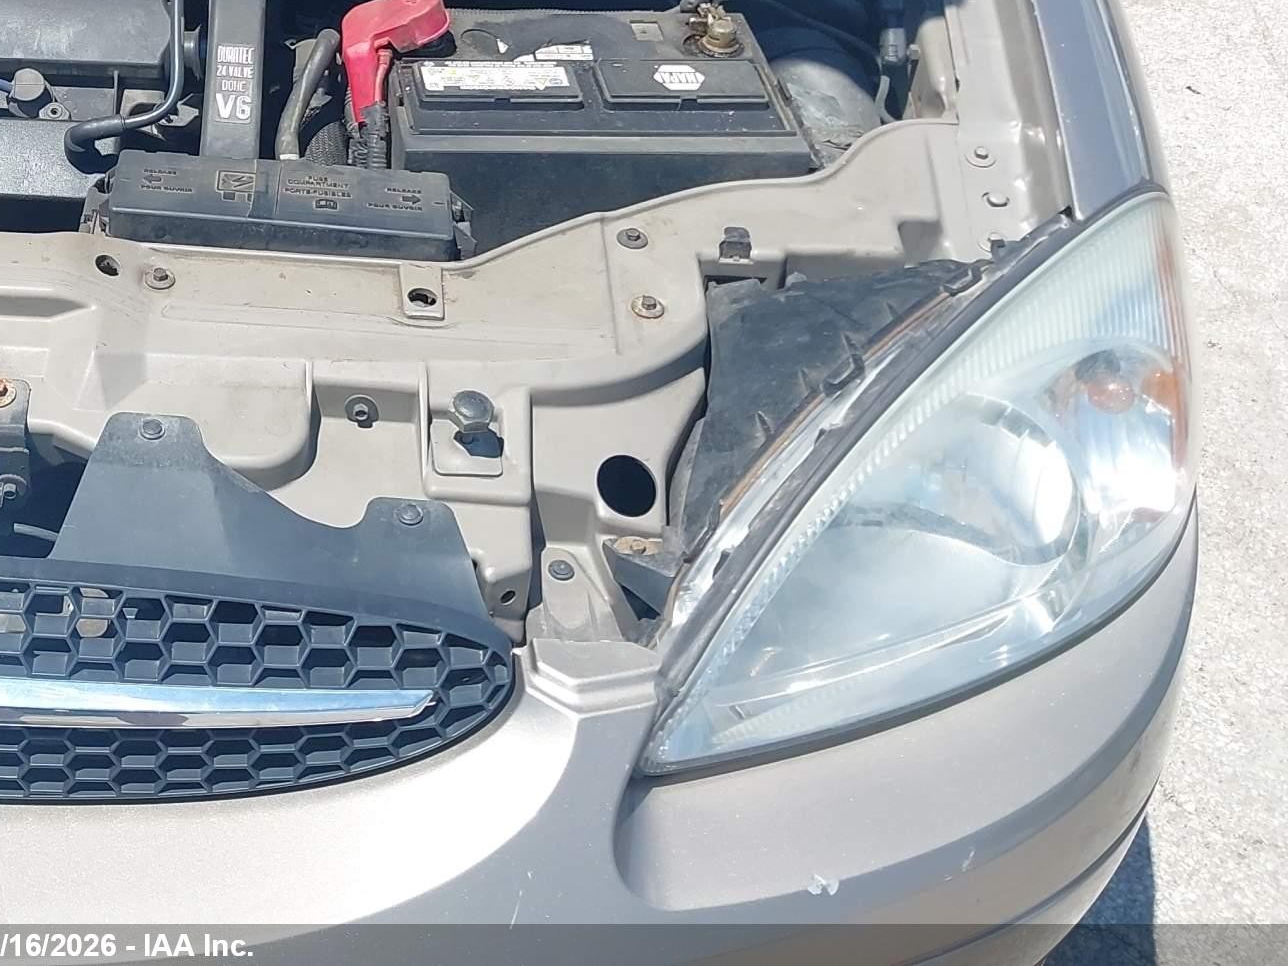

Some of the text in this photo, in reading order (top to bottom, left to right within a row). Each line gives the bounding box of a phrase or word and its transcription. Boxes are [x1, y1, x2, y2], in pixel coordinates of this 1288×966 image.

[217, 46, 254, 64] DURATEC
[217, 65, 254, 79] 24 VALVE
[216, 94, 251, 120] V6
